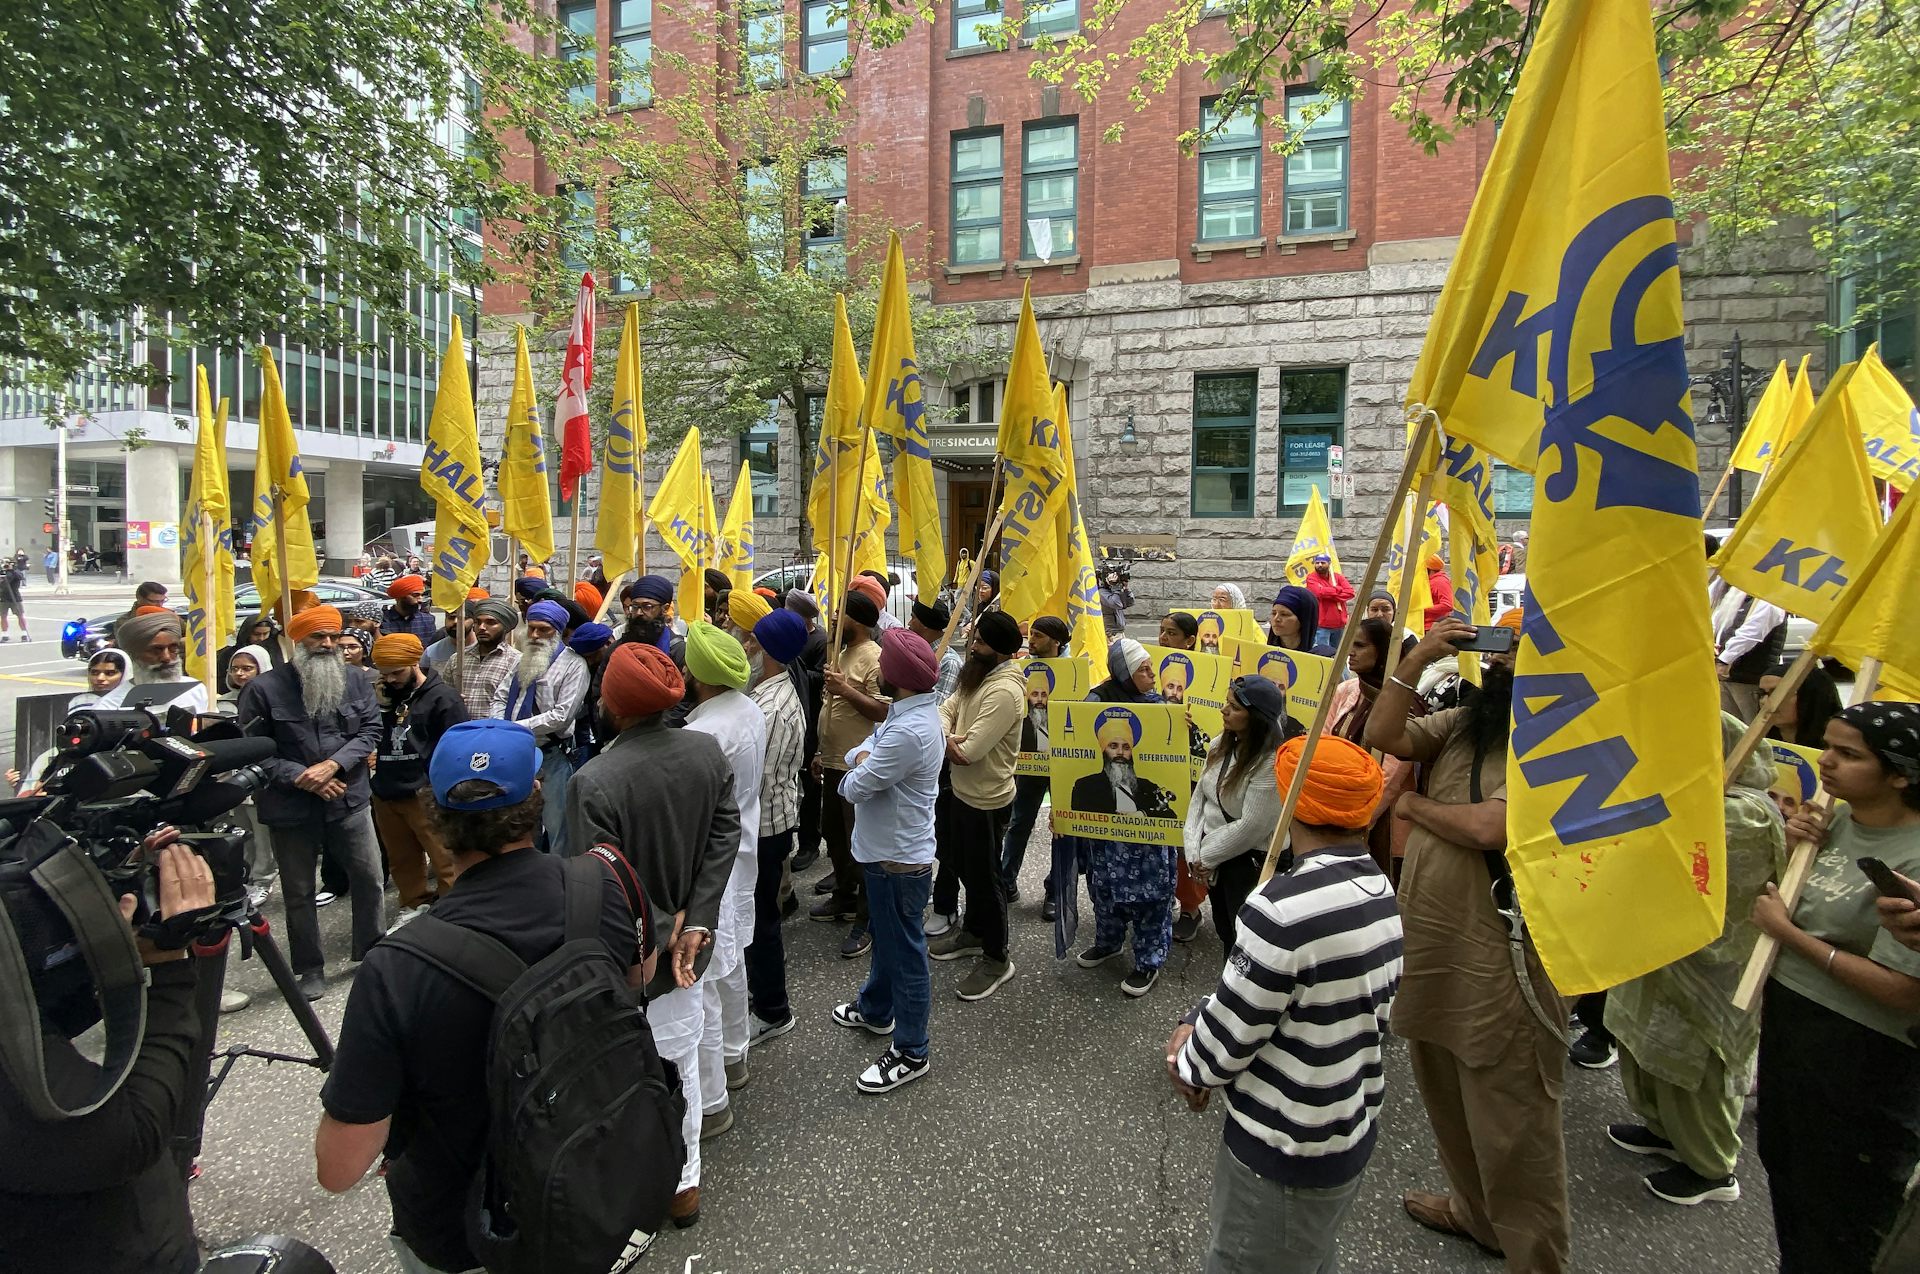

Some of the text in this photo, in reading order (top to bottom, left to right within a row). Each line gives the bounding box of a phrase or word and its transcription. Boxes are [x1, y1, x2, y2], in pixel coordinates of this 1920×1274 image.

[1018, 752, 1050, 761] LLED CANA
[1051, 747, 1186, 763] KHALISTAN REFERENDUM
[1016, 763, 1032, 771] DEEP
[1055, 810, 1185, 829] MODI KILLED CANADIAN CITIZE
[1072, 824, 1165, 841] HARDEEP SINGH NIJJAR
